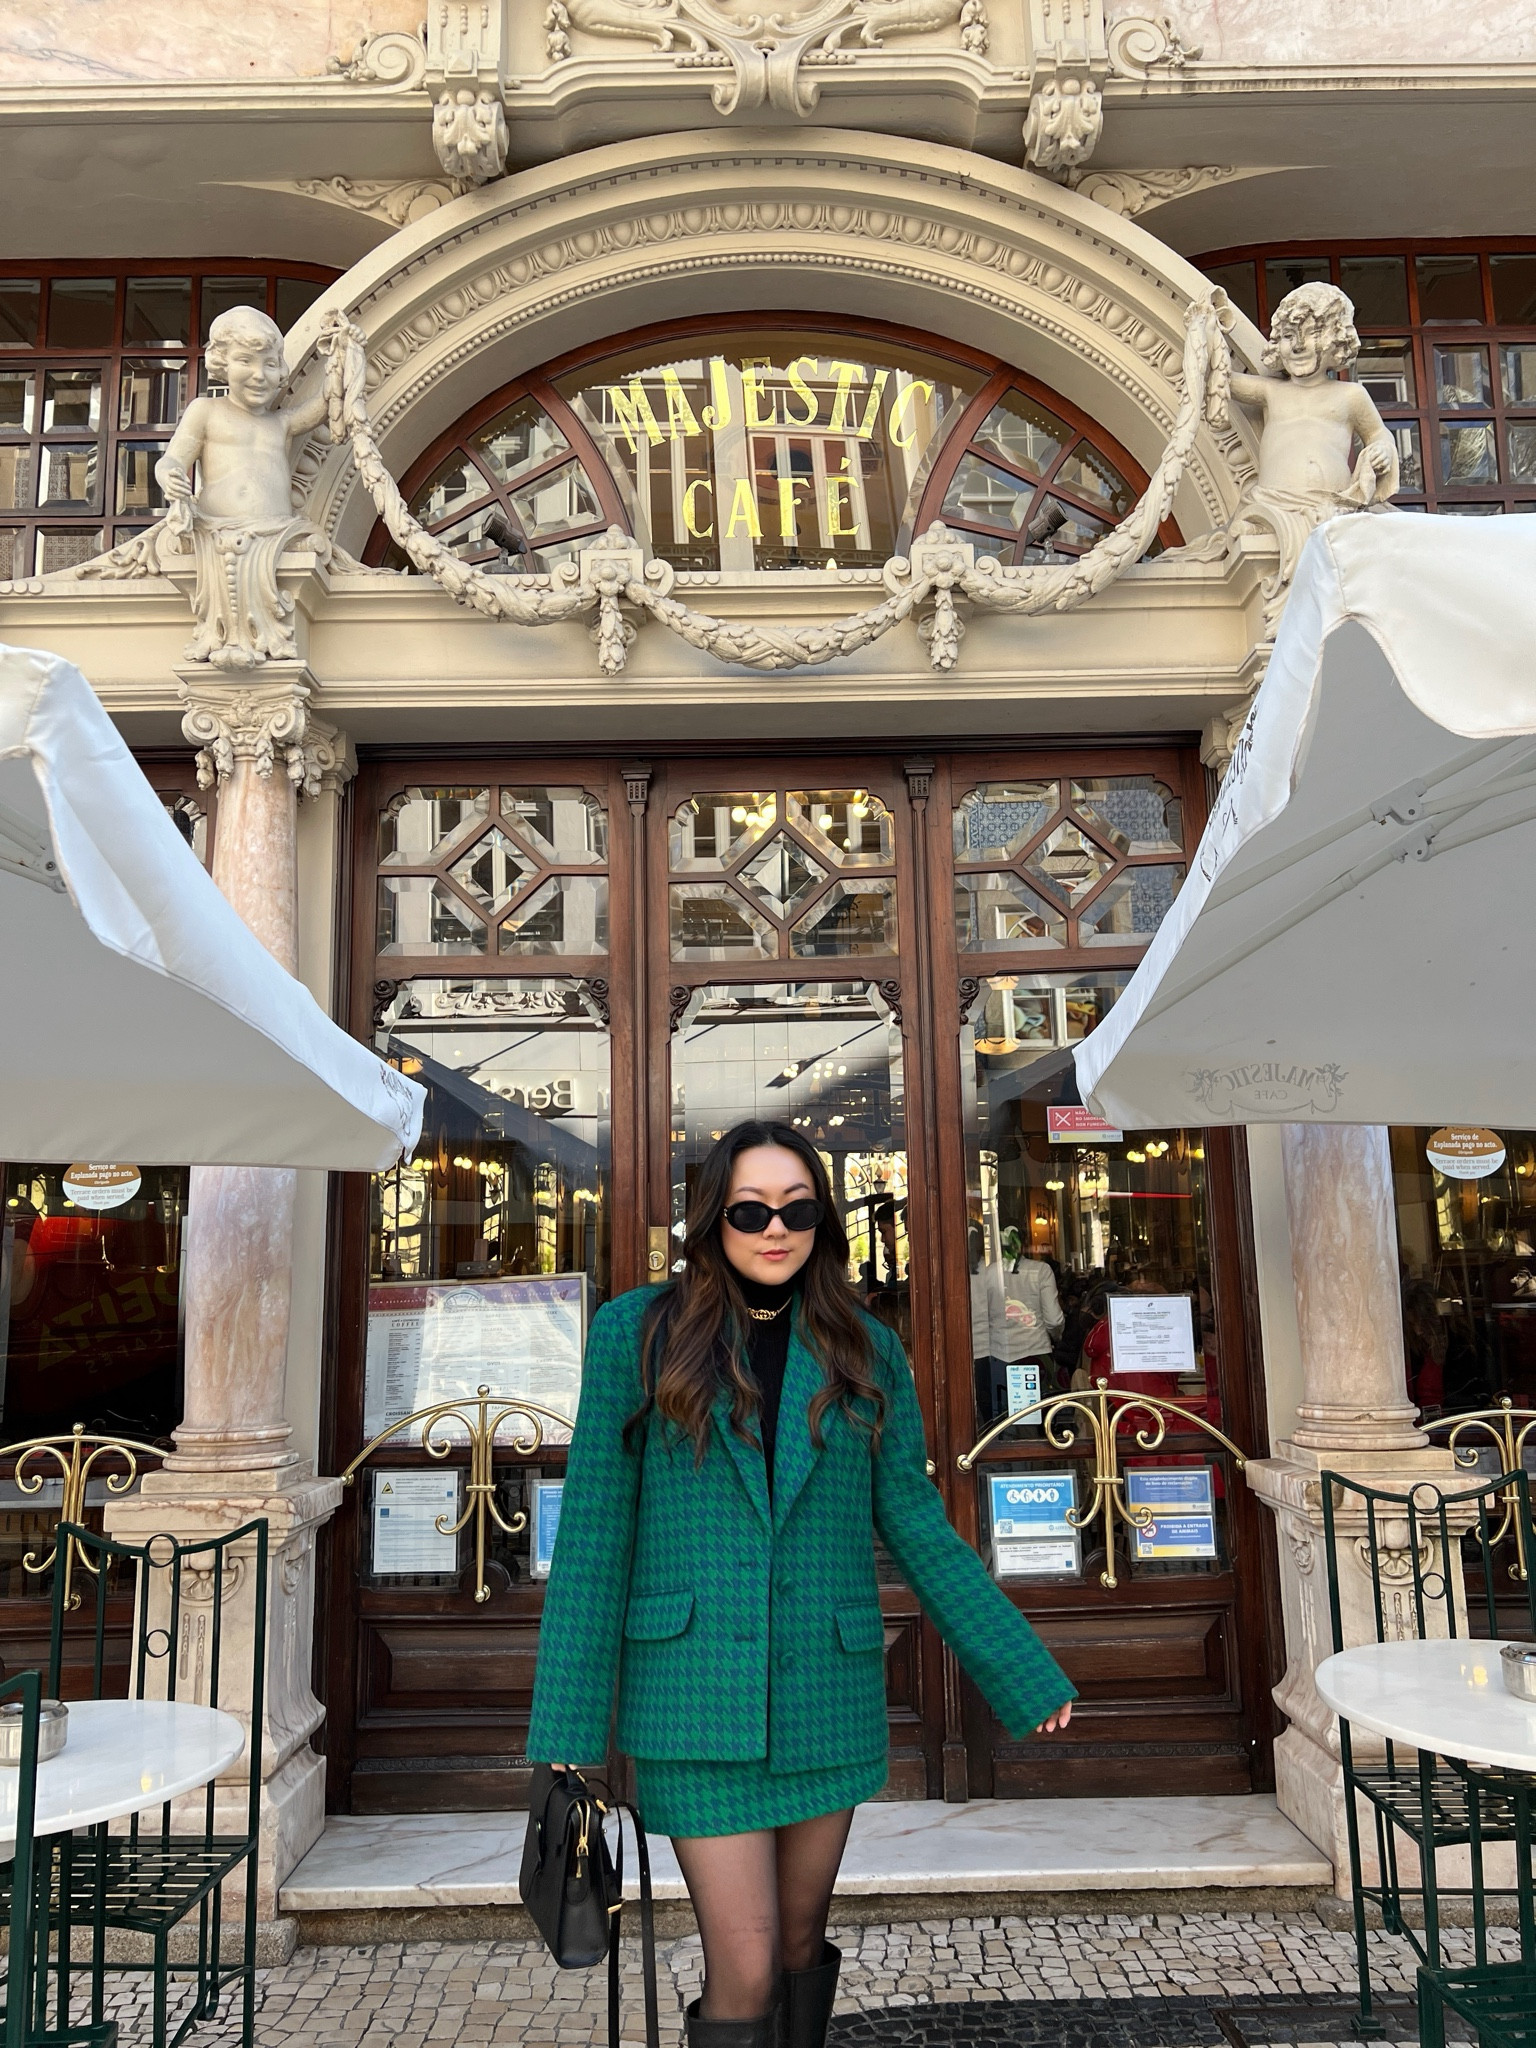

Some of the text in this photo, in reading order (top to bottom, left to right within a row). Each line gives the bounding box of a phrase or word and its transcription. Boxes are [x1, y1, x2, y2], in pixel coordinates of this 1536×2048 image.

[607, 356, 933, 455] MAJESTIC
[682, 456, 860, 538] CAFÉ
[1450, 1133, 1471, 1141] Serviço
[1433, 1141, 1461, 1149] Esplanada
[70, 1171, 98, 1180] Esplanada
[99, 1171, 112, 1180] pago
